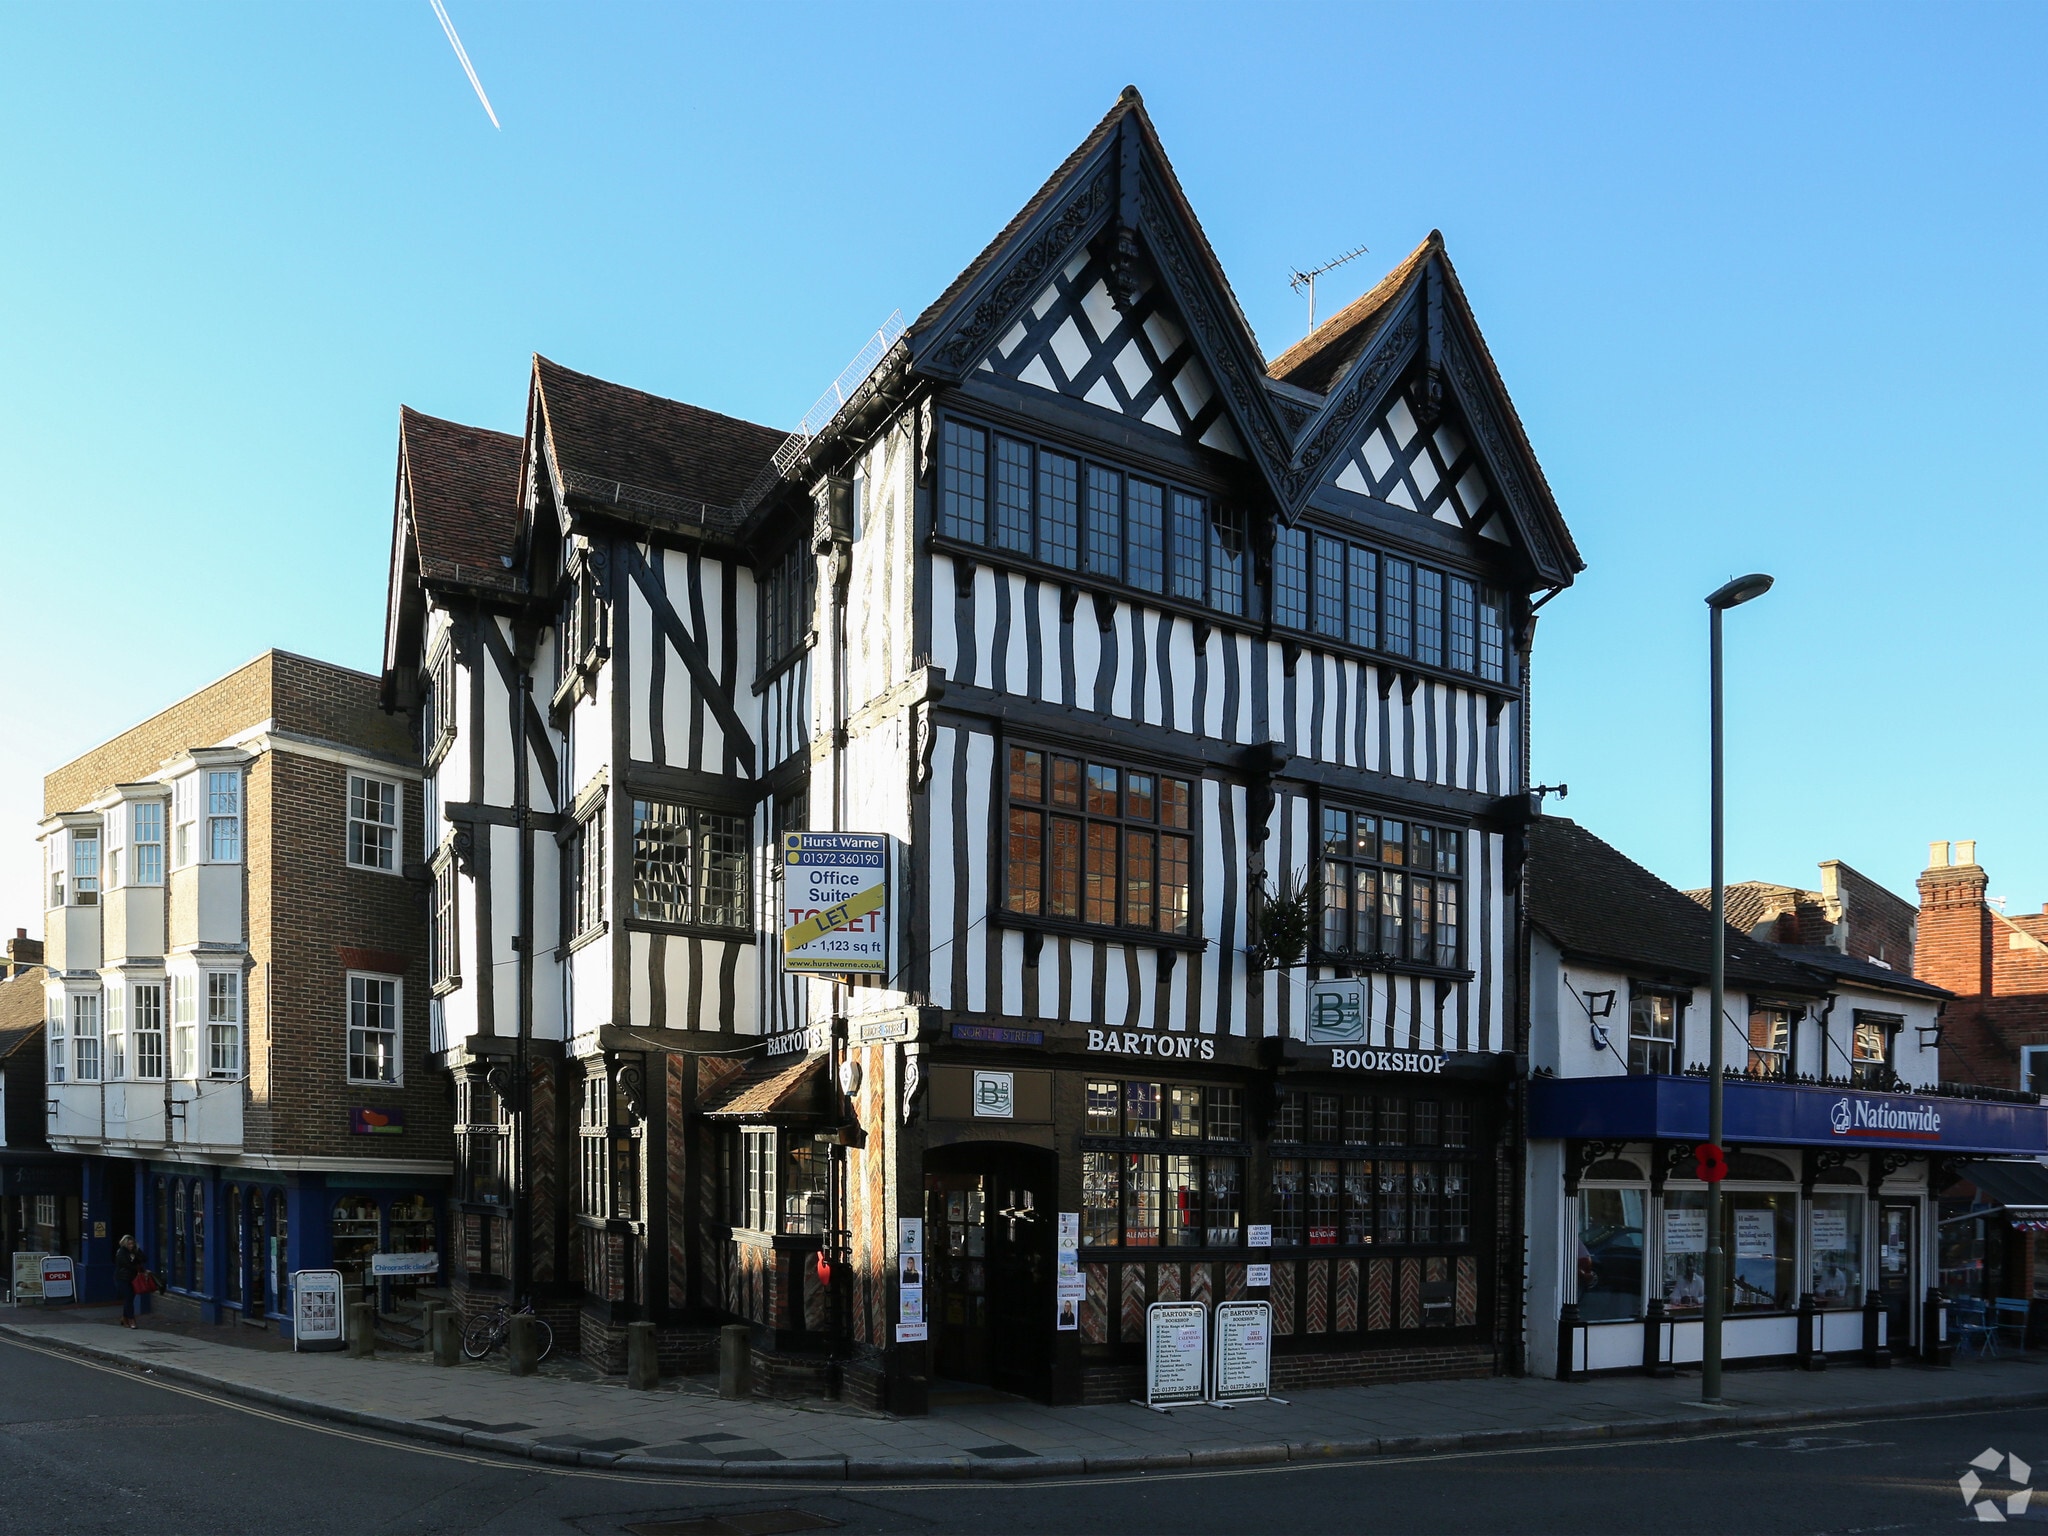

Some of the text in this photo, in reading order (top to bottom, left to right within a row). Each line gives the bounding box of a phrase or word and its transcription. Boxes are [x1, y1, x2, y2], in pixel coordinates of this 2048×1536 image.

[803, 837, 880, 848] Hurst Warne
[803, 853, 879, 865] 01372 360190
[810, 870, 859, 885] Office
[816, 904, 848, 932] LET
[820, 940, 849, 952] 1,123
[853, 943, 868, 954] sq
[872, 942, 881, 952] ft
[788, 960, 882, 969] www.hurstwarne.co.uk
[766, 1028, 823, 1056] BARTON'S
[958, 1027, 1039, 1042] NORTH STREET
[1087, 1030, 1215, 1060] BARTON'S
[1331, 1048, 1445, 1074] BOOKSHOP
[1854, 1100, 1941, 1132] Nationwide
[375, 1264, 412, 1272] Chiropractic
